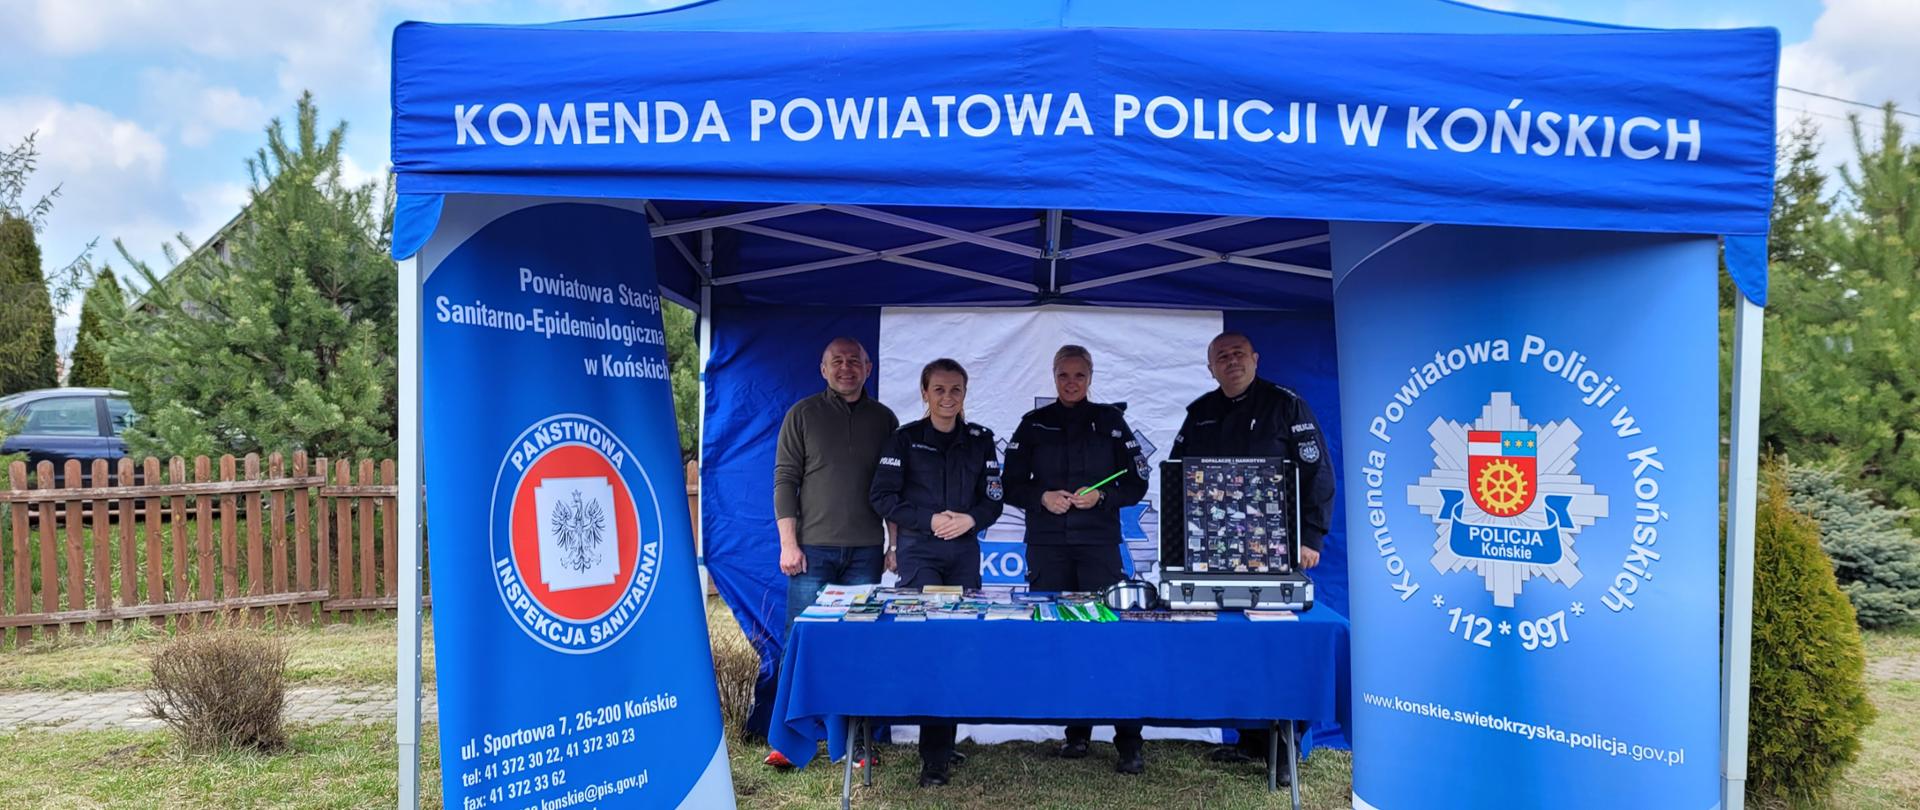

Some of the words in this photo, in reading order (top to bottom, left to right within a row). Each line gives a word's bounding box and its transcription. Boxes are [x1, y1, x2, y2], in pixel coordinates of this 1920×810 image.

[455, 100, 731, 146] KOMENDA
[750, 92, 1094, 142] POWIATOWA
[1114, 94, 1317, 144] POLICJI
[1337, 104, 1388, 147] W
[1406, 98, 1701, 161] KOŃSKICH
[519, 267, 614, 304] Powiatowa
[618, 283, 661, 314] Stacja
[436, 295, 665, 347] Sanitarno-Epidemiologiczna
[584, 359, 598, 376] w
[602, 354, 670, 381] Końskich
[1369, 338, 1510, 444] Powiatowa
[1520, 334, 1621, 408] Policji
[511, 421, 624, 473] PAŃSTWOWA
[1291, 423, 1315, 433] POLICJA
[1610, 405, 1642, 439] w
[879, 456, 901, 467] POLICJA
[1362, 449, 1420, 602] Komenda
[1469, 526, 1543, 547] POLICJA
[1481, 541, 1532, 560] Końskie
[1600, 446, 1669, 614] Końskich
[497, 557, 586, 646] INSPEKCJA
[590, 541, 658, 644] SANITARNA
[1448, 607, 1493, 648] 112
[1518, 610, 1571, 651] 997
[461, 738, 480, 761] ul.
[484, 723, 556, 756] Sportowa
[559, 716, 573, 735] 7,
[575, 703, 621, 732] 26-200
[624, 692, 678, 720] Końskie
[1363, 691, 1685, 767] www.konskie.swietokrzyska.policja.gov.pl
[462, 769, 482, 787] tel:
[484, 763, 498, 780] 41
[502, 756, 525, 776] 372
[528, 752, 543, 768] 30
[546, 747, 564, 764] 22,
[566, 741, 580, 759] 41
[583, 735, 604, 754] 372
[606, 731, 620, 748] 30
[622, 727, 636, 744] 23
[463, 795, 487, 810] fax:
[489, 786, 504, 804] 41
[508, 780, 532, 799] 372
[534, 775, 549, 793] 33
[551, 769, 567, 786] 62
